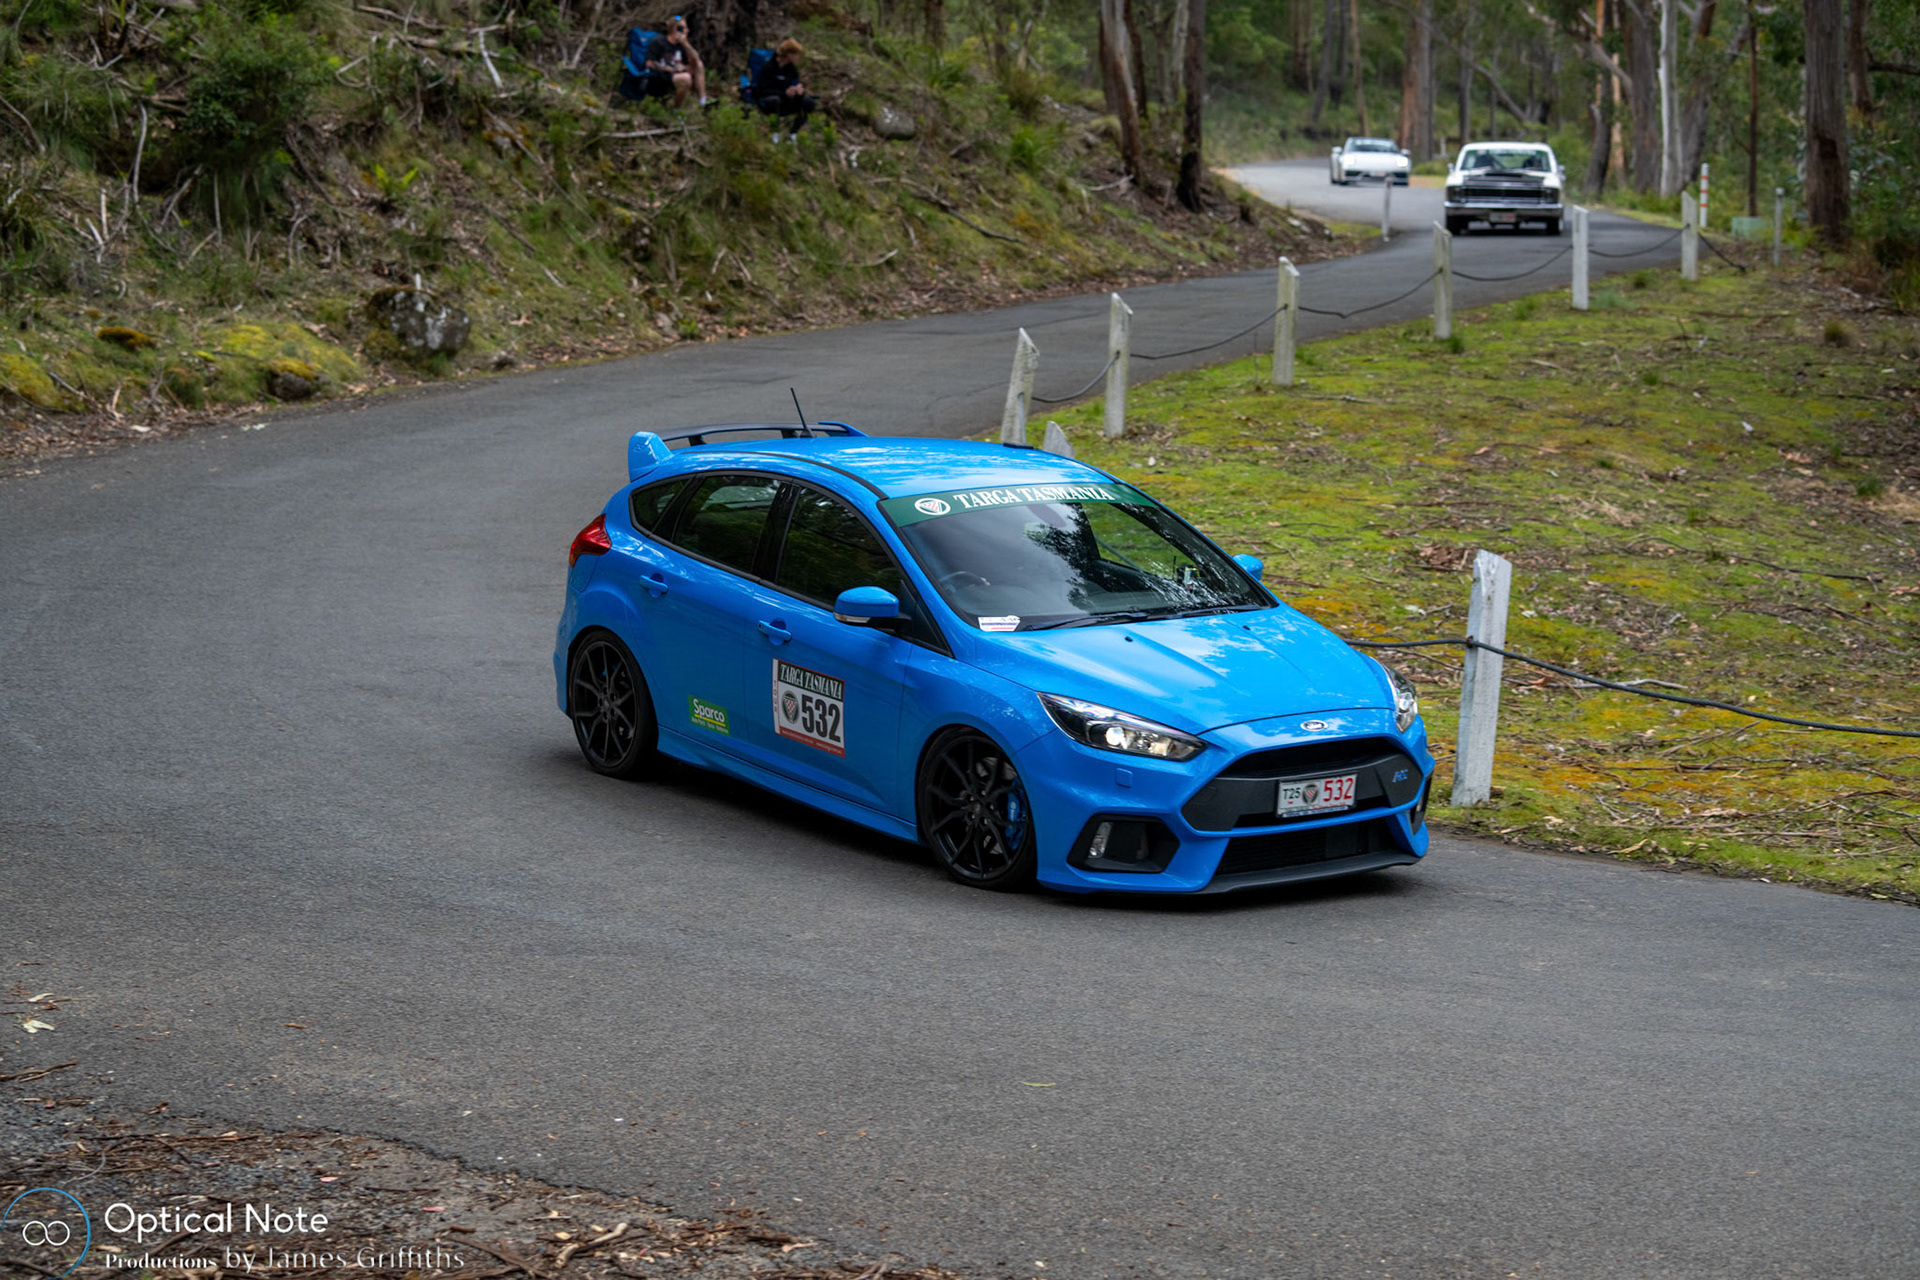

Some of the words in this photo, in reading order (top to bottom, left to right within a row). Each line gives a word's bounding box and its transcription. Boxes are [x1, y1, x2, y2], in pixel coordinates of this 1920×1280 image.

[953, 488, 1022, 509] TARGA
[1017, 486, 1115, 502] TASMANIA
[780, 663, 803, 687] TARGA
[804, 671, 842, 699] TASMANIA
[693, 698, 725, 723] Sparco
[801, 693, 842, 743] 532
[1282, 787, 1301, 800] T25
[1323, 777, 1354, 802] 532
